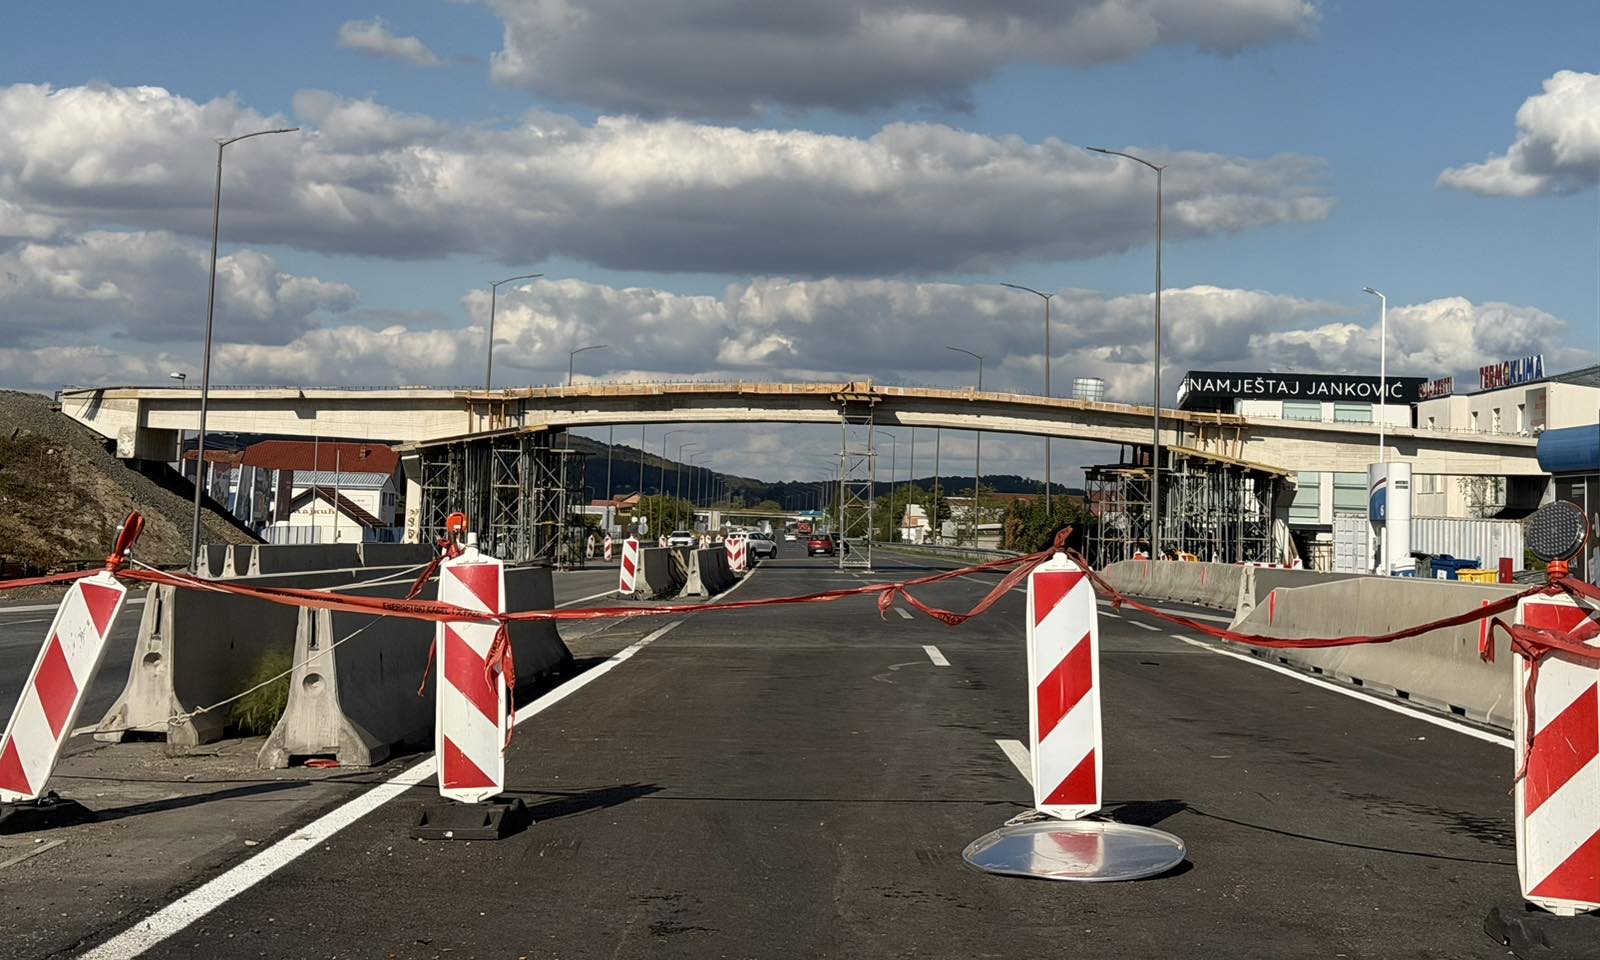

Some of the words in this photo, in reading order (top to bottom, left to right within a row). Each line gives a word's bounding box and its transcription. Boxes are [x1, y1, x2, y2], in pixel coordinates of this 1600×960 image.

[1480, 354, 1544, 389] TERMOKLIMA
[1190, 377, 1299, 394] NAMJEŠTAJ
[1306, 381, 1403, 398] JANKOVIĆ
